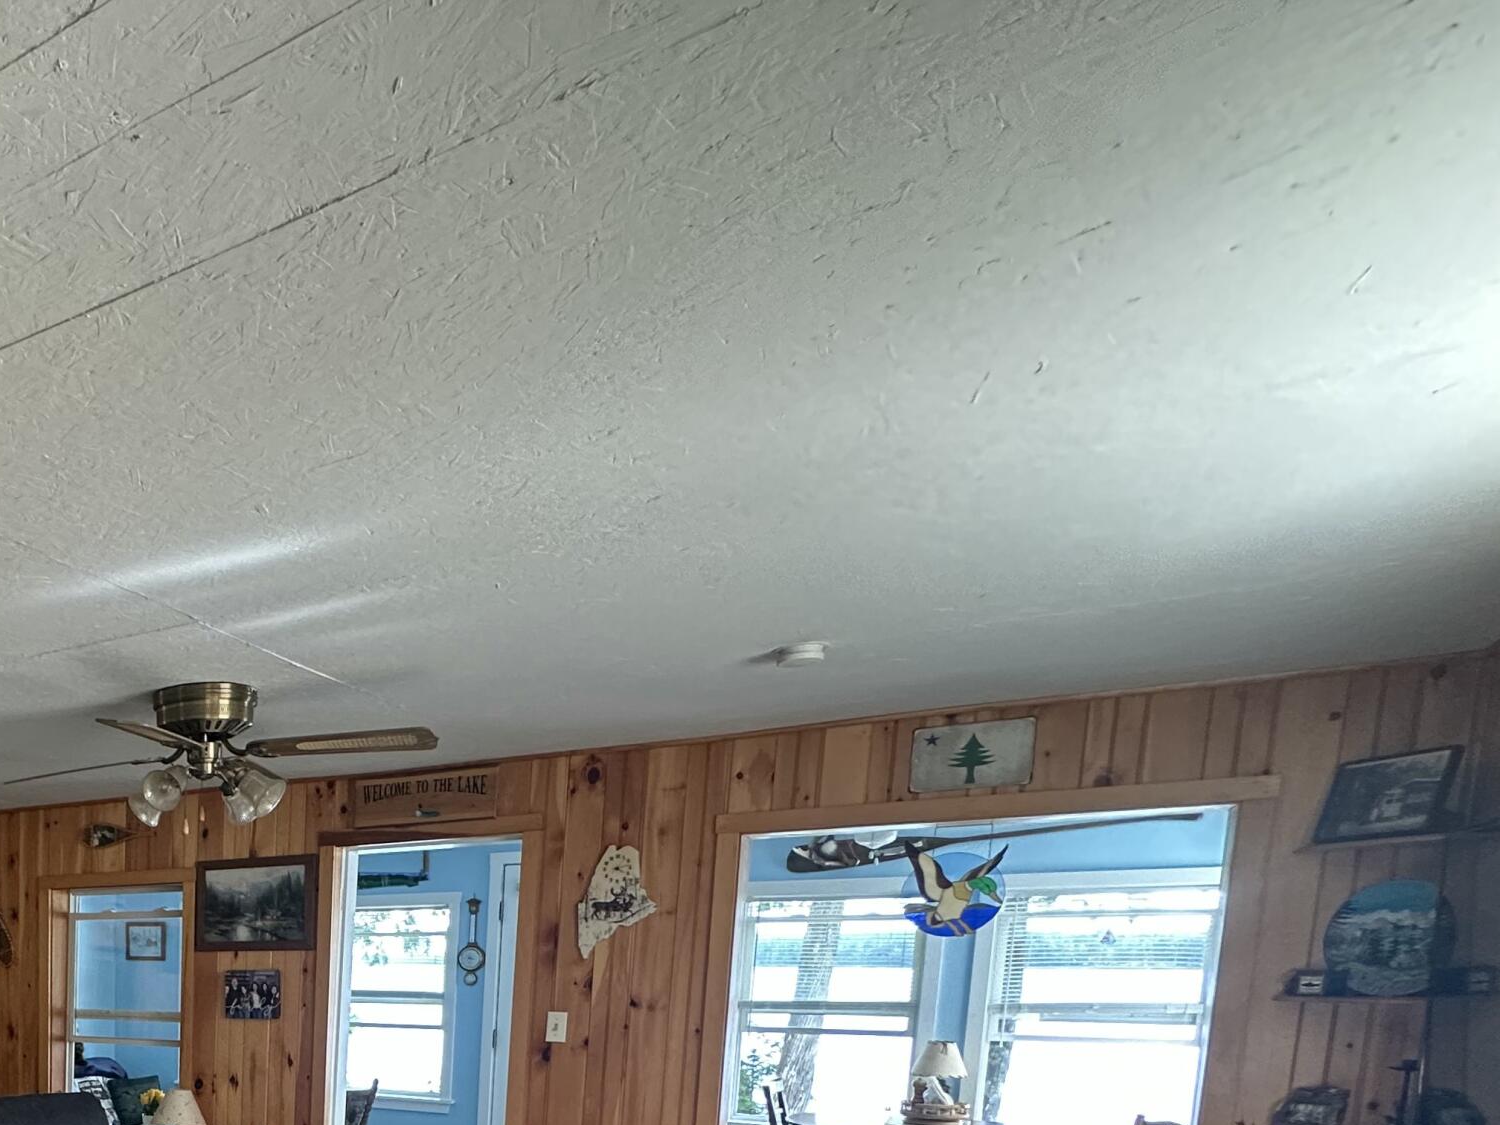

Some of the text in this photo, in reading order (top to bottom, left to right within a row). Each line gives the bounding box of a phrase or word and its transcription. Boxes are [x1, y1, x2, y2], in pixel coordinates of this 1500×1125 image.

[363, 774, 487, 804] WELCOME TO THE LAKE
